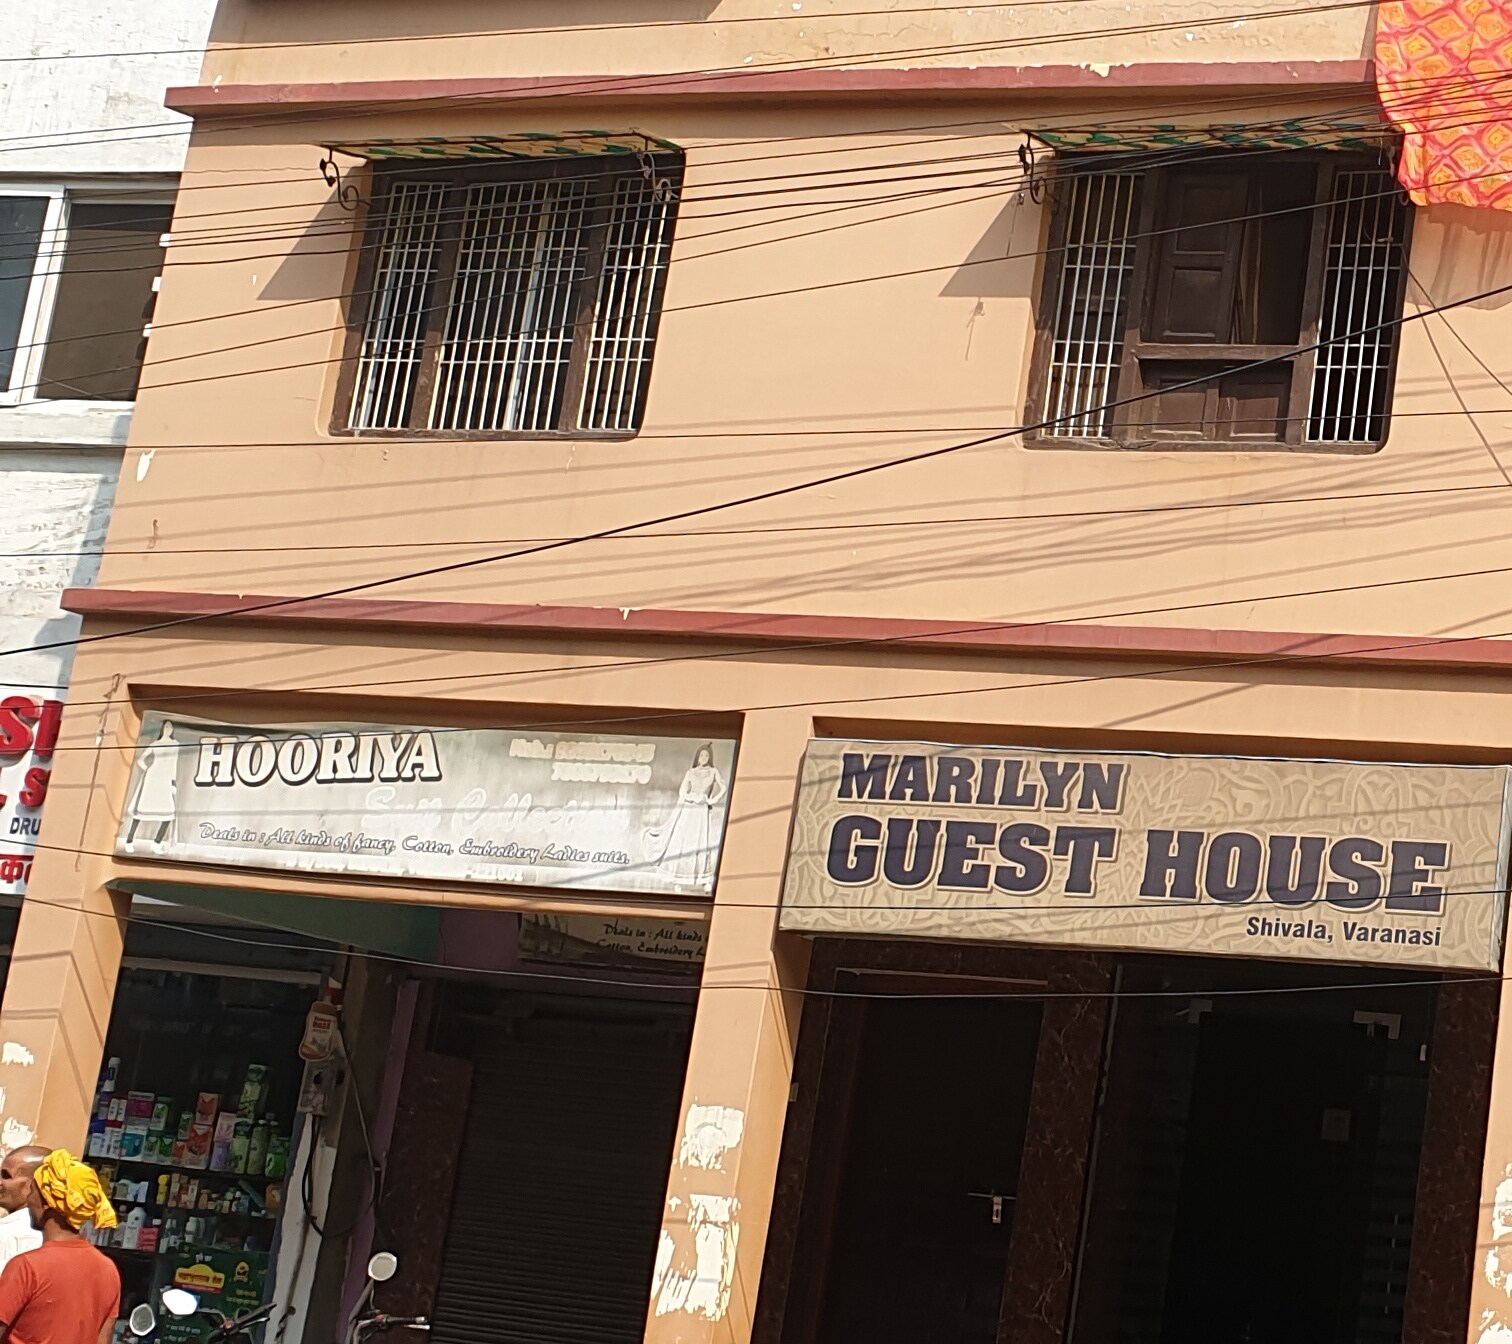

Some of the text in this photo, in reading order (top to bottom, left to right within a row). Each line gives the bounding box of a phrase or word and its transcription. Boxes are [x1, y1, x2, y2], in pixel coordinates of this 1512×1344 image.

[194, 730, 443, 787] HOORIYA
[836, 751, 1130, 812] MARILYN
[199, 822, 240, 841] Deals
[243, 829, 257, 842] in
[263, 828, 293, 846] All
[295, 830, 332, 847] kinds
[334, 832, 351, 853] of
[458, 838, 540, 864] Embroidery
[541, 843, 590, 863] Ladies
[824, 814, 1452, 915] GUEST HOUSE
[1245, 915, 1442, 948] Shivala, Varanasi
